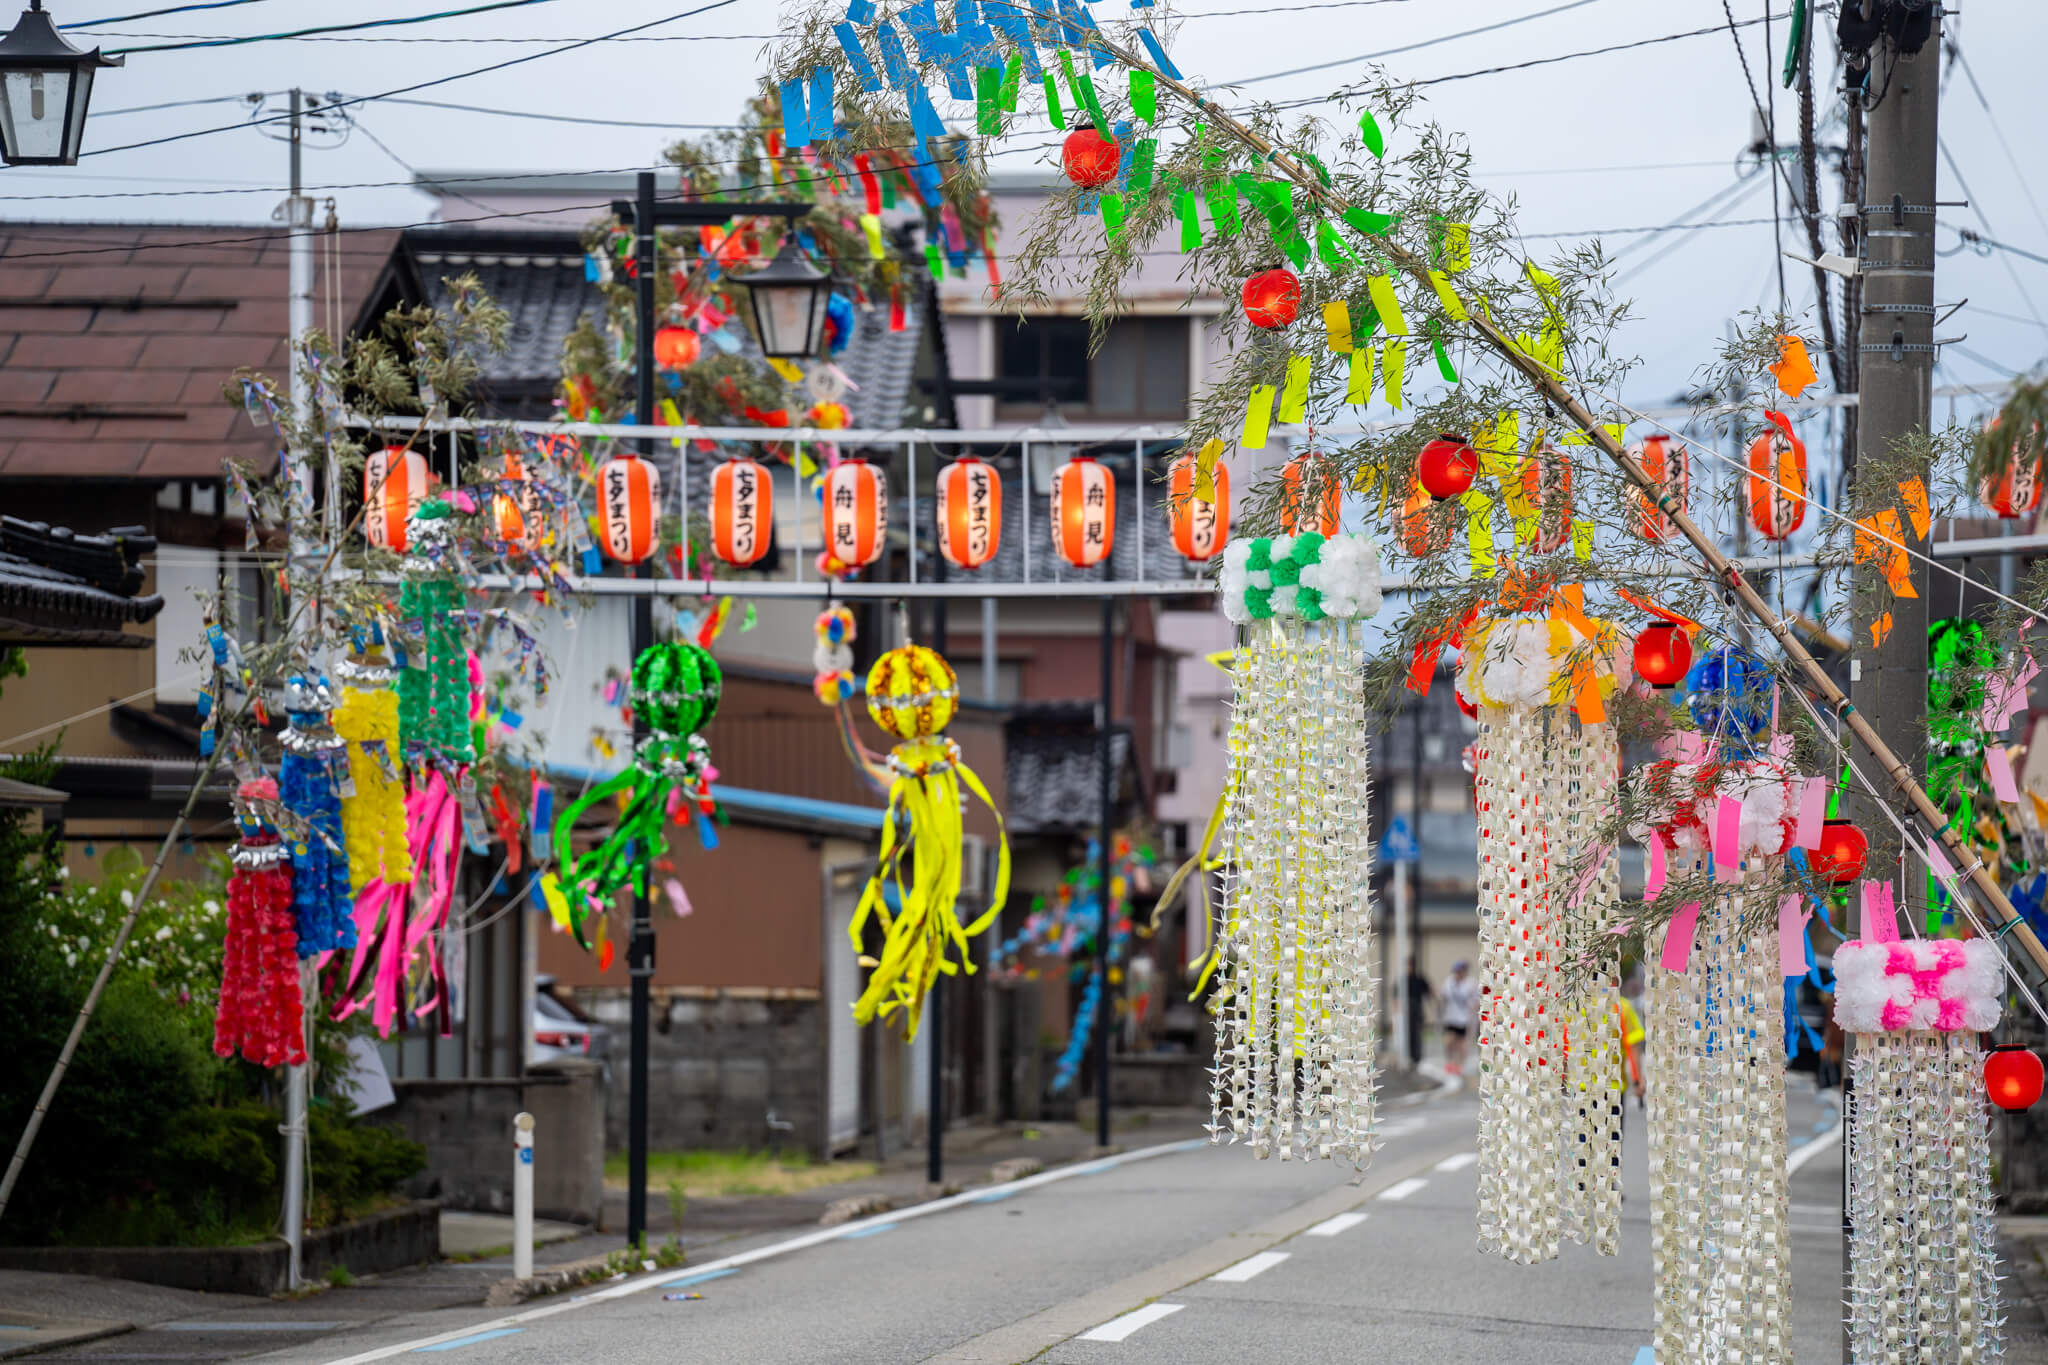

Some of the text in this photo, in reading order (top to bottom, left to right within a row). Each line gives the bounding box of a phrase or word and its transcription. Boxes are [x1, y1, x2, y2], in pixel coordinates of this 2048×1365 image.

[608, 469, 627, 552] 七夕まつり
[738, 470, 753, 552] 七夕まつり
[836, 485, 853, 545] 舟見
[972, 472, 988, 555] 七夕まつり
[1087, 482, 1103, 544] 舟見
